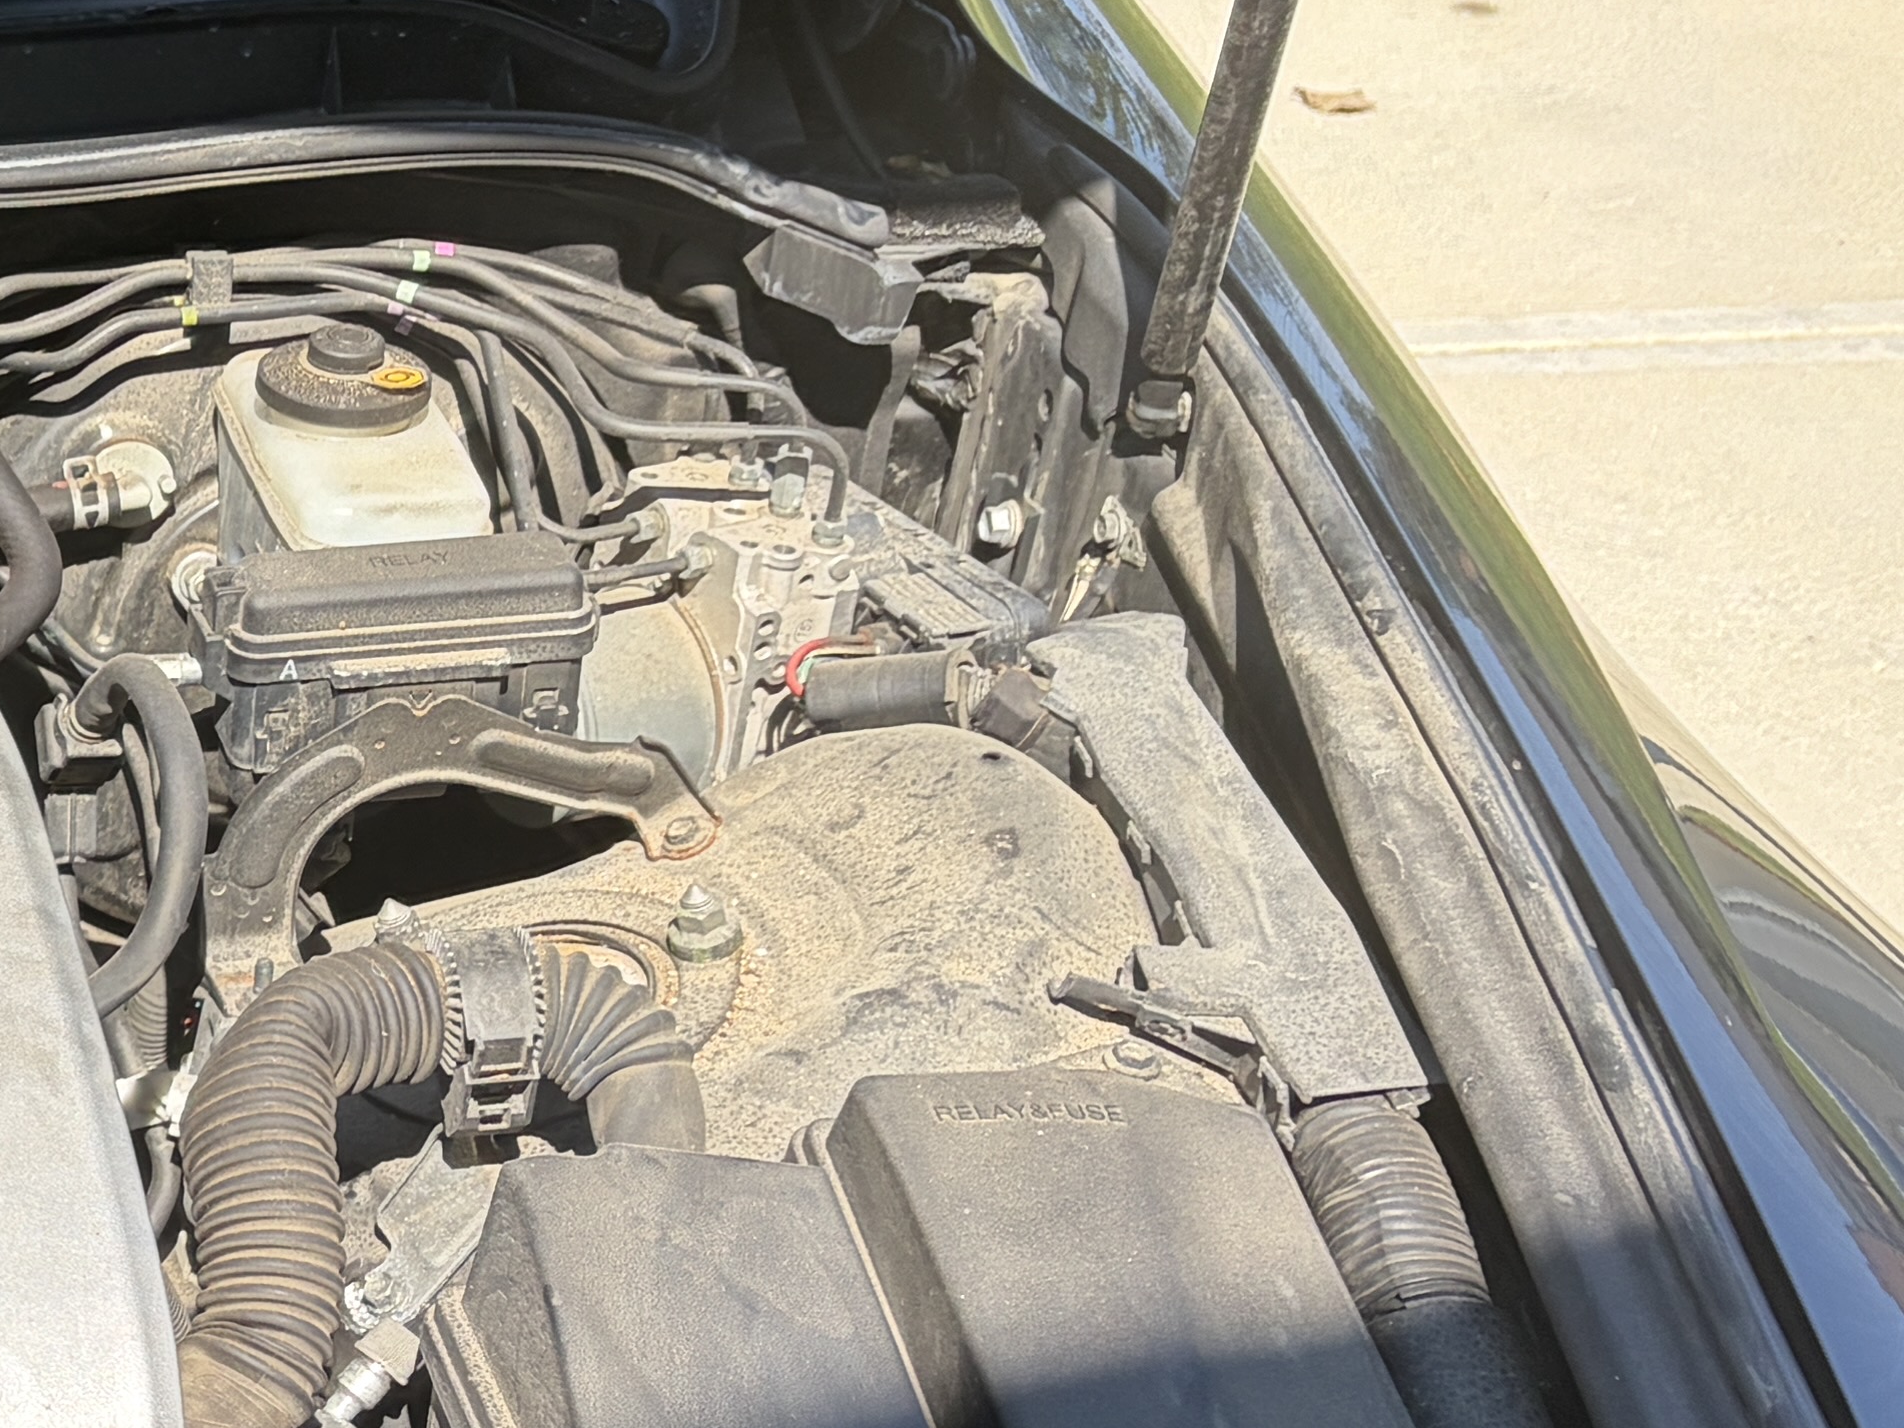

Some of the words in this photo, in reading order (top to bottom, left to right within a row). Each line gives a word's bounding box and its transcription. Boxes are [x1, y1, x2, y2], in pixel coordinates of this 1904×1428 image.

[368, 550, 450, 569] RELAY
[278, 658, 299, 681] A
[933, 1103, 1126, 1123] RELAY&FUSE
